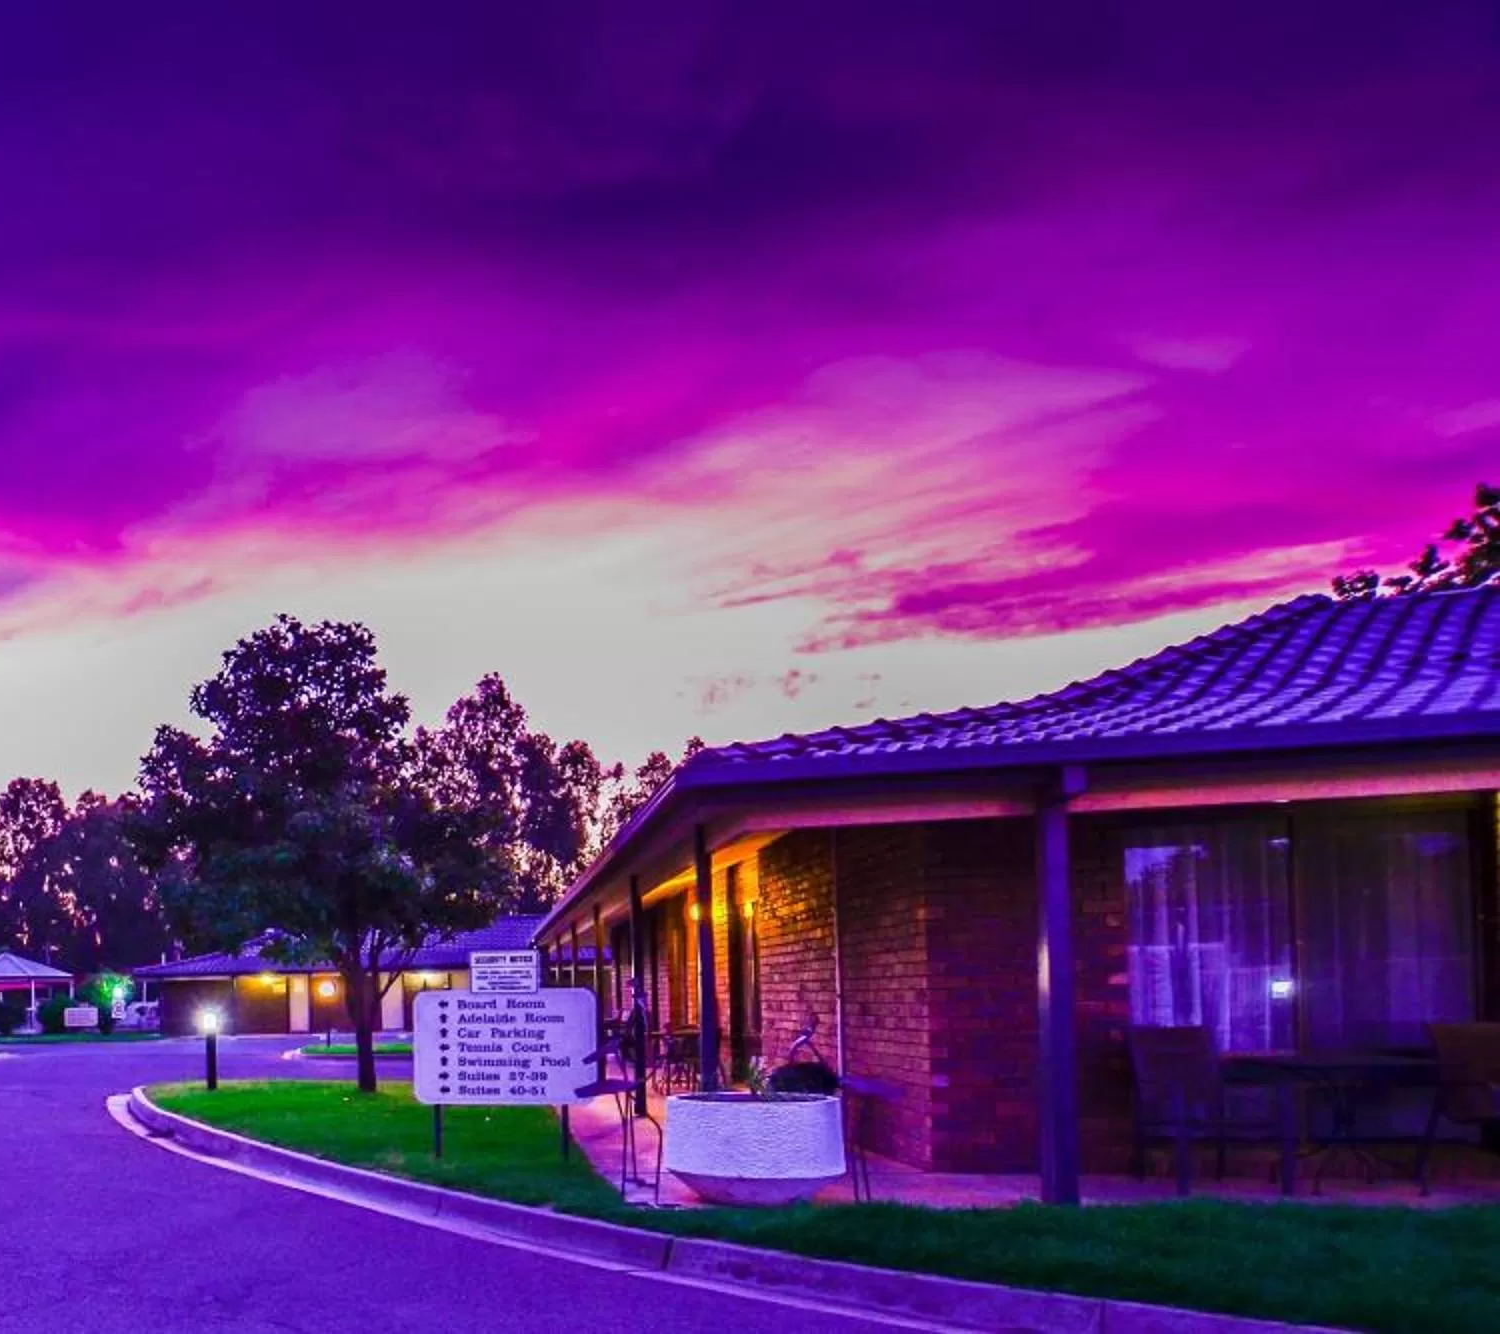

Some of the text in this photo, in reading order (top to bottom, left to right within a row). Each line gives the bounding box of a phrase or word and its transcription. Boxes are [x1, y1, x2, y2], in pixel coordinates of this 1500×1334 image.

[457, 999, 546, 1009] Board Room
[457, 1013, 565, 1023] Adelaide Room
[457, 1028, 546, 1040] Car Parking
[457, 1042, 551, 1053] Tennis Court
[458, 1056, 571, 1068] Swimming Pool
[458, 1071, 500, 1081] Suites
[458, 1085, 546, 1096] Suites 40-51
